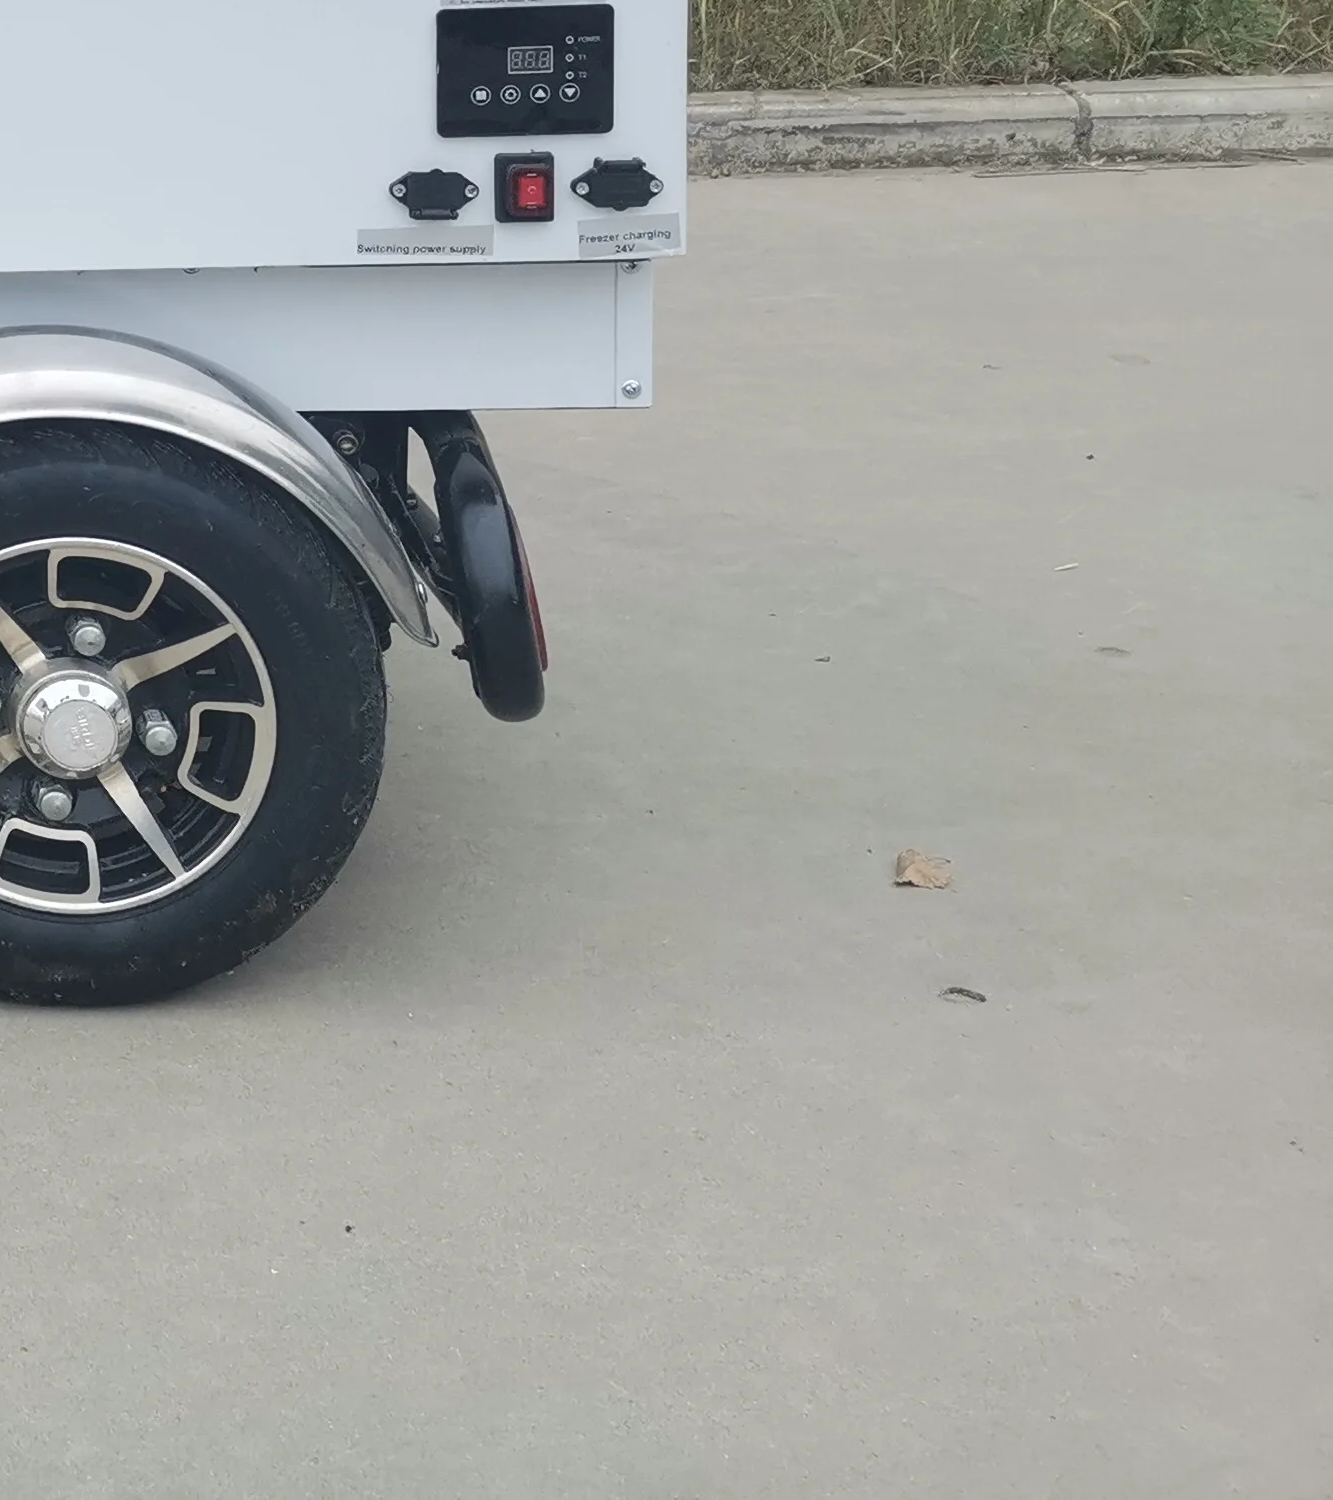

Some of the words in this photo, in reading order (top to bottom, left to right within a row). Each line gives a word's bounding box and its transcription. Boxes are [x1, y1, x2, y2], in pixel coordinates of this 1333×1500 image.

[577, 35, 601, 43] POWER
[578, 71, 588, 79] T2
[578, 233, 620, 245] Freezer
[622, 228, 672, 241] charging
[356, 243, 410, 256] Switching
[412, 245, 447, 256] power
[449, 244, 487, 256] supply
[614, 243, 636, 254] 24V
